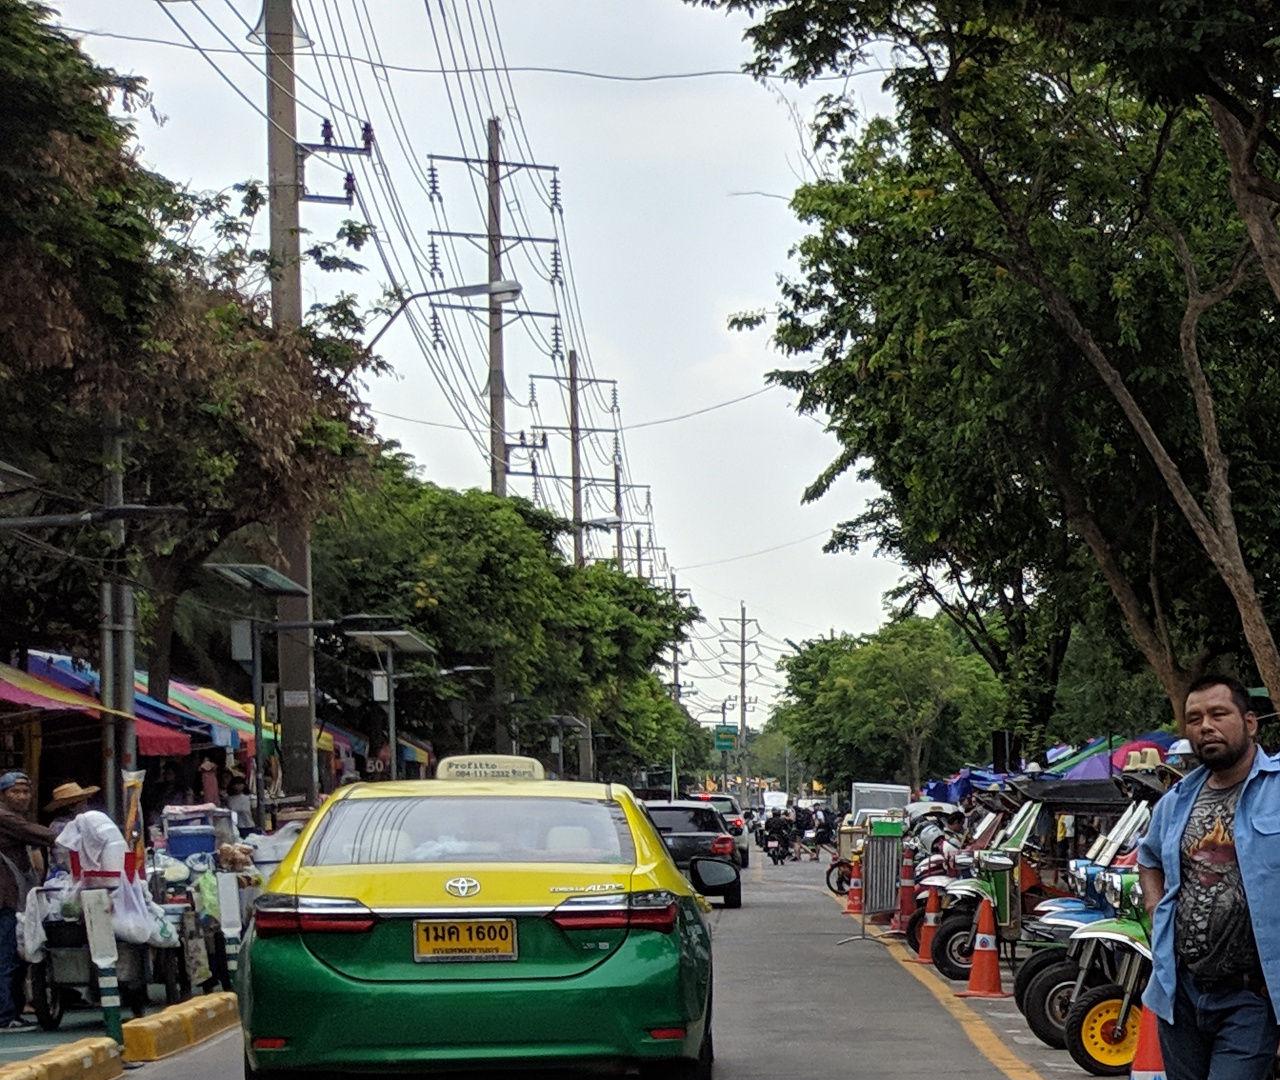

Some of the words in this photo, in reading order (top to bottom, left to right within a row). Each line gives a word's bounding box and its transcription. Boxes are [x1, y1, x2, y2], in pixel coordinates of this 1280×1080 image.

[366, 760, 384, 773] 50
[423, 925, 460, 942] 1มค
[466, 925, 509, 941] 1600
